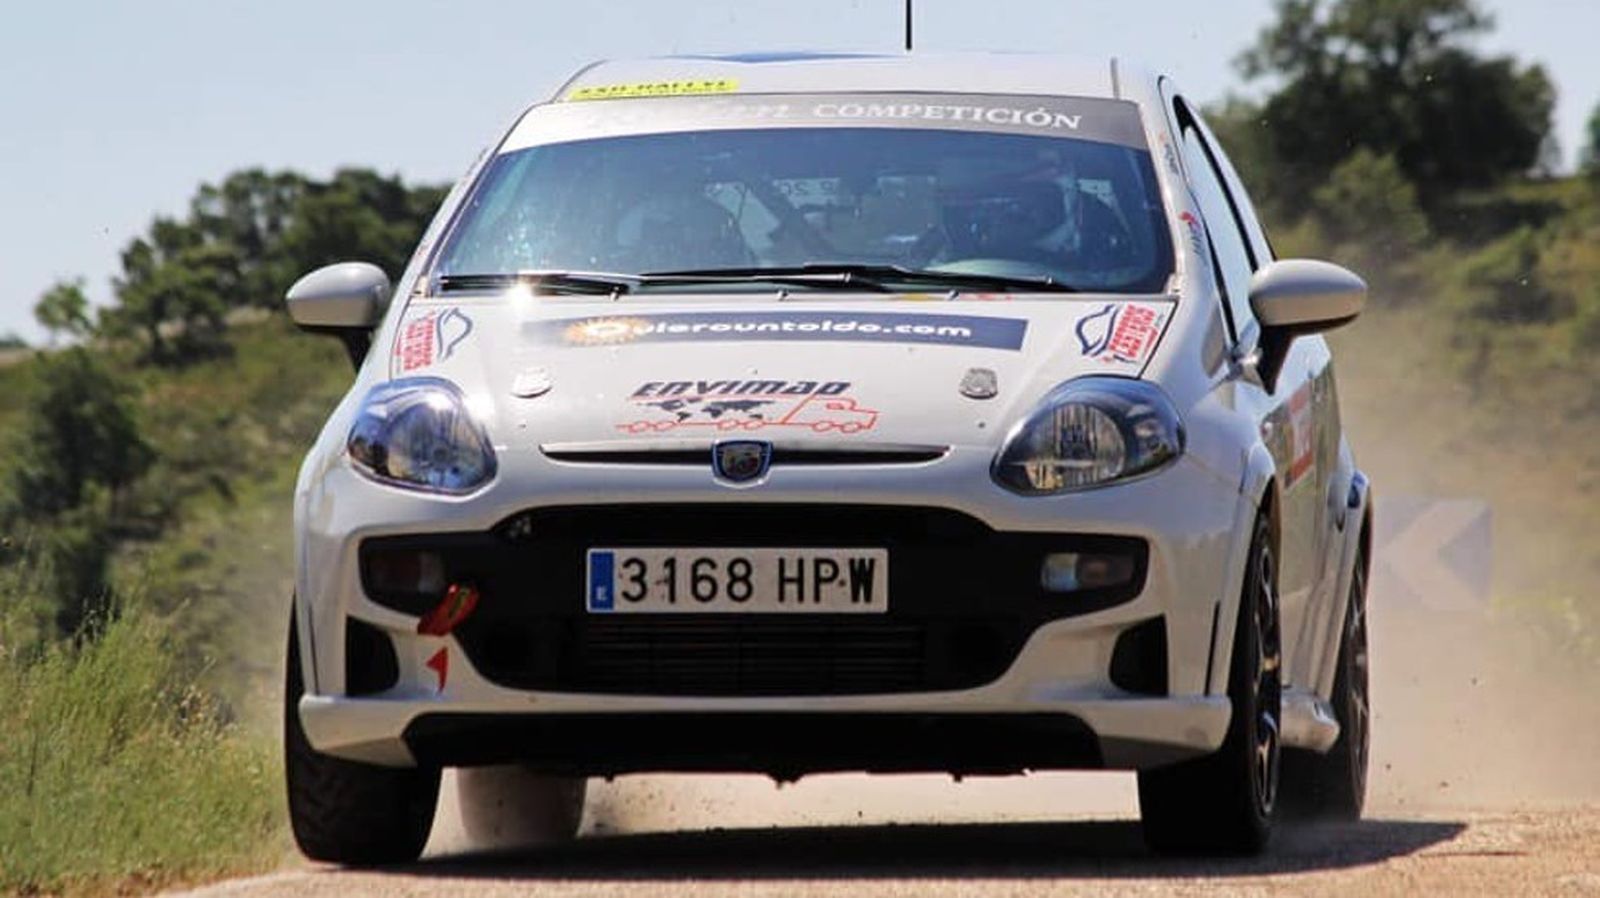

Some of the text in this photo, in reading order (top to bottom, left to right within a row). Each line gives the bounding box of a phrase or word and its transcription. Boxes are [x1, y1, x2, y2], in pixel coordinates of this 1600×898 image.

[812, 103, 1083, 130] COMPETICIÓN
[596, 586, 608, 601] E
[620, 557, 876, 604] 3168 HPW
